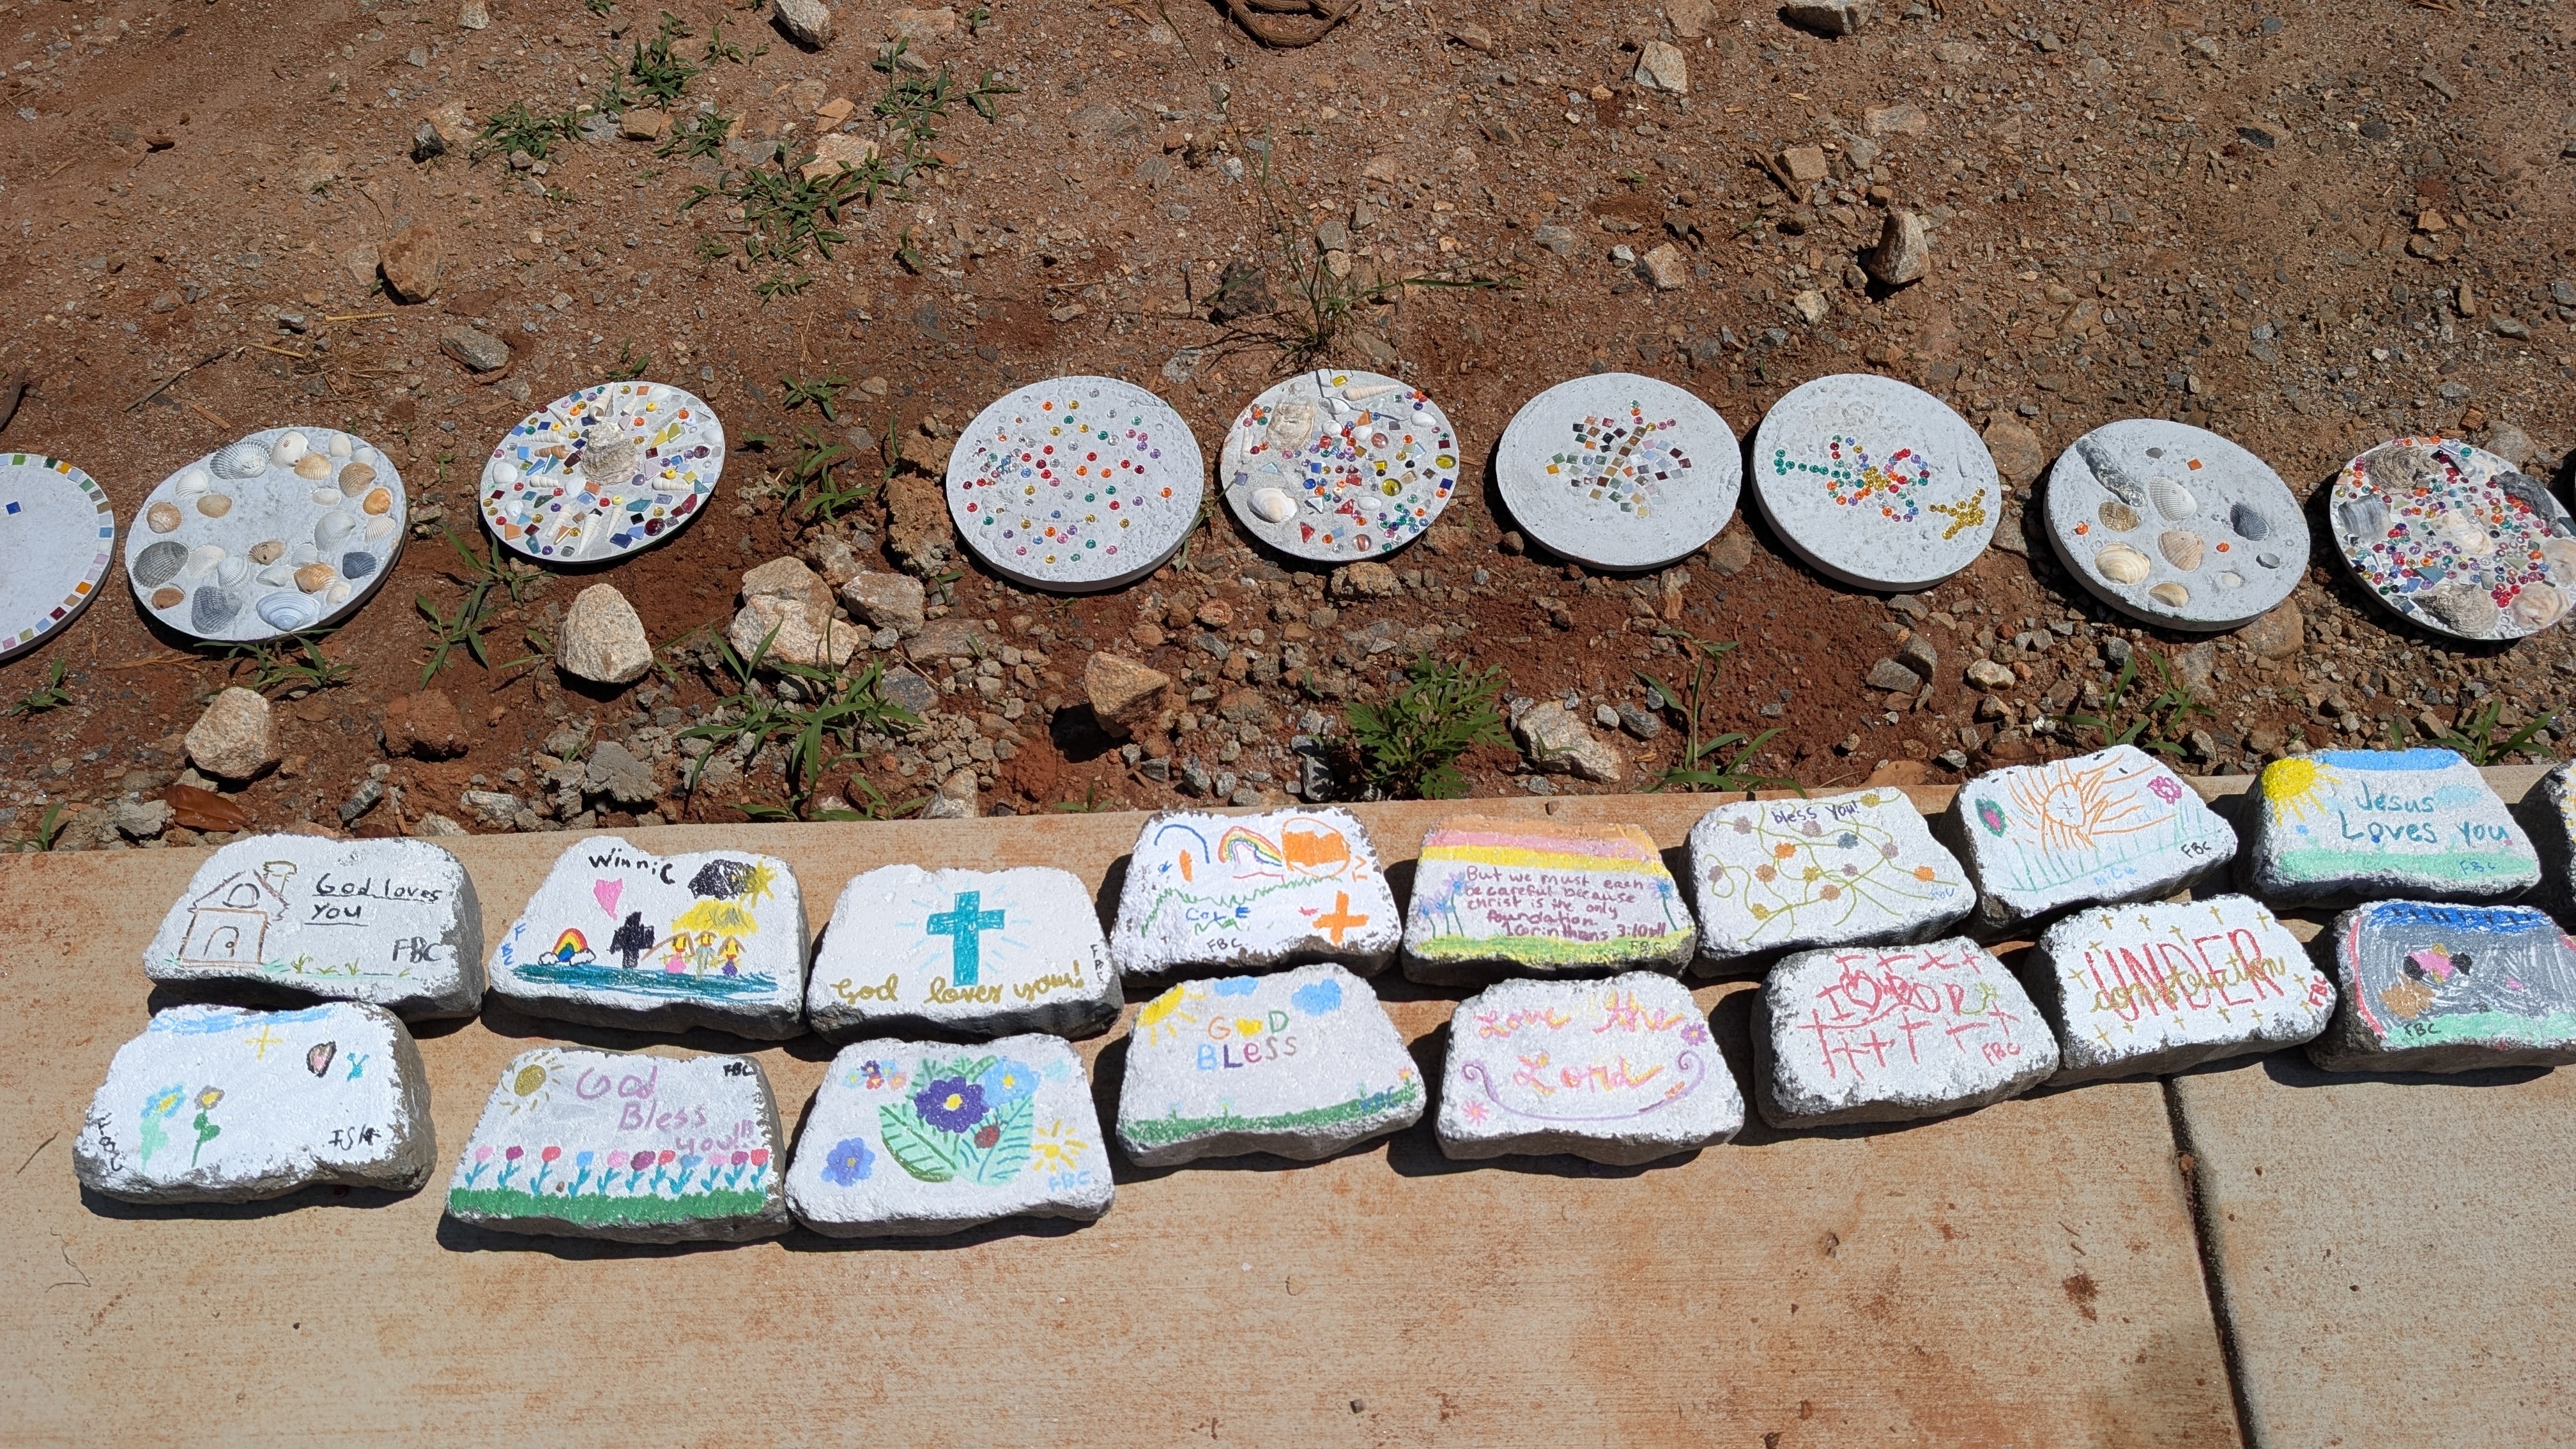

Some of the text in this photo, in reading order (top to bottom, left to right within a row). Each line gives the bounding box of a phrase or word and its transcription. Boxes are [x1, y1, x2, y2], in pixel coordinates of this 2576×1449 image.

[2354, 779, 2435, 813] Jesus
[2180, 840, 2212, 859] FBC
[1466, 865, 1644, 891] But we must each
[2458, 859, 2496, 876] FBC
[316, 873, 443, 903] God loves
[1486, 884, 1552, 897] careful
[1531, 898, 1544, 908] is
[1585, 901, 1619, 920] only
[391, 937, 442, 963] FBC
[1206, 937, 1243, 953] FBC
[830, 959, 1085, 1006] God loves you!
[2083, 928, 2285, 1022] UNDER
[2308, 974, 2328, 1008] FBC
[2403, 1022, 2442, 1039] FBC
[1981, 1041, 2021, 1068] FBC
[723, 1061, 756, 1077] FBC
[576, 1065, 658, 1100] God
[618, 1098, 707, 1132] Bless
